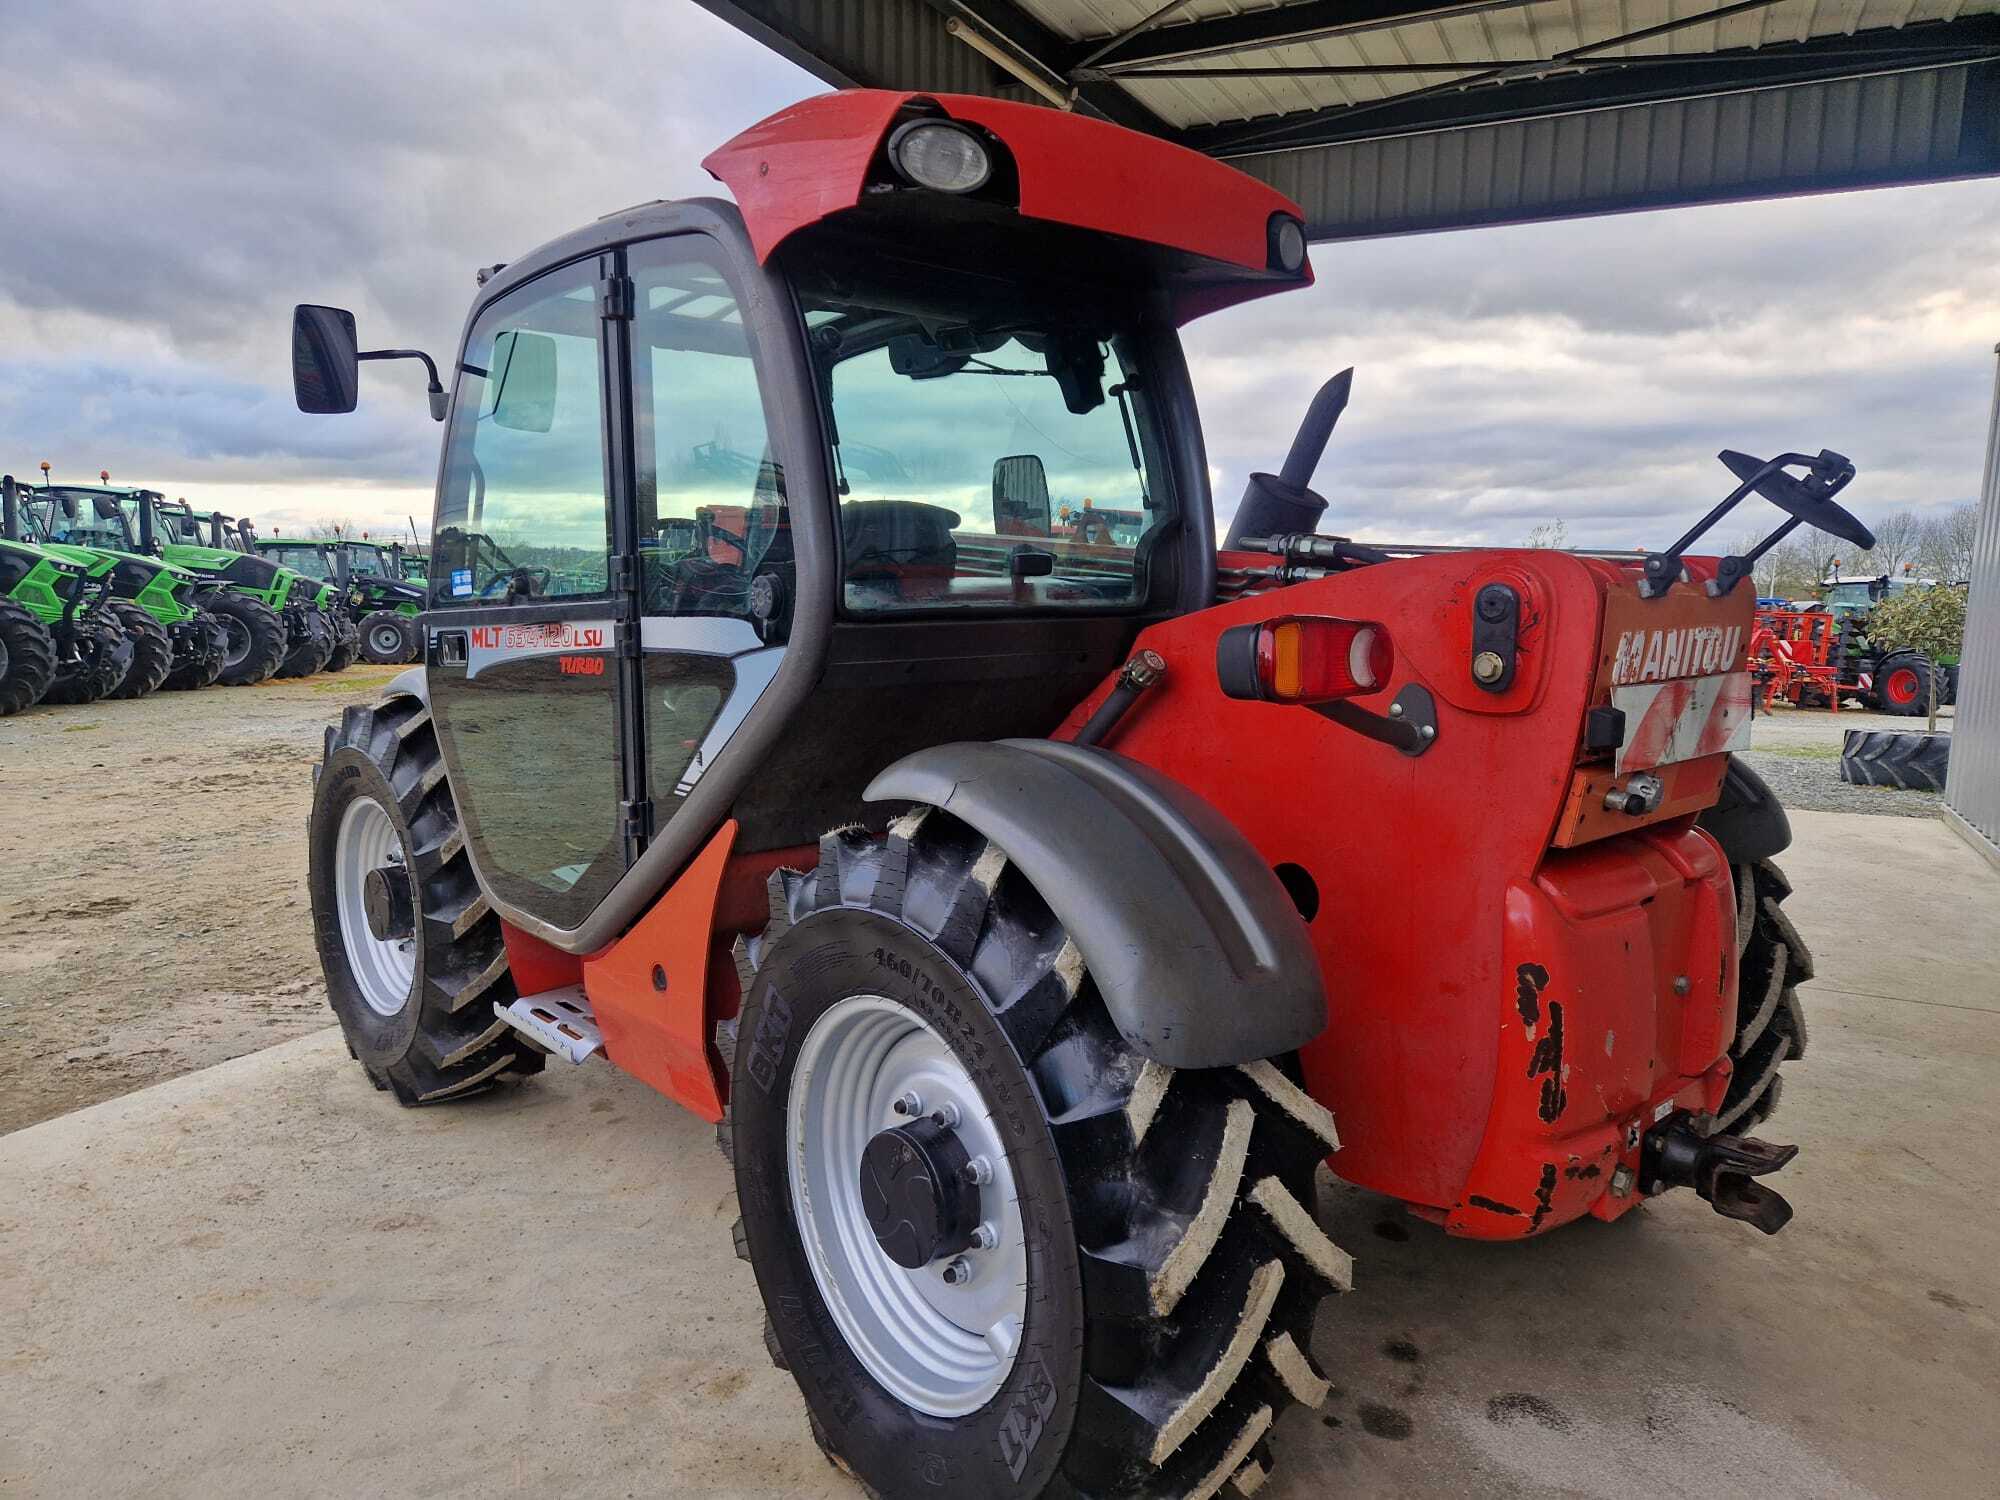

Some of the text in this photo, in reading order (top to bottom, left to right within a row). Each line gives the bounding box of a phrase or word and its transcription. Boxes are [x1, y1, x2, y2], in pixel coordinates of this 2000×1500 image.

[471, 627, 503, 649] MLT
[574, 629, 603, 647] LSU
[1611, 625, 1742, 684] MANITOU
[559, 656, 606, 676] TURBO
